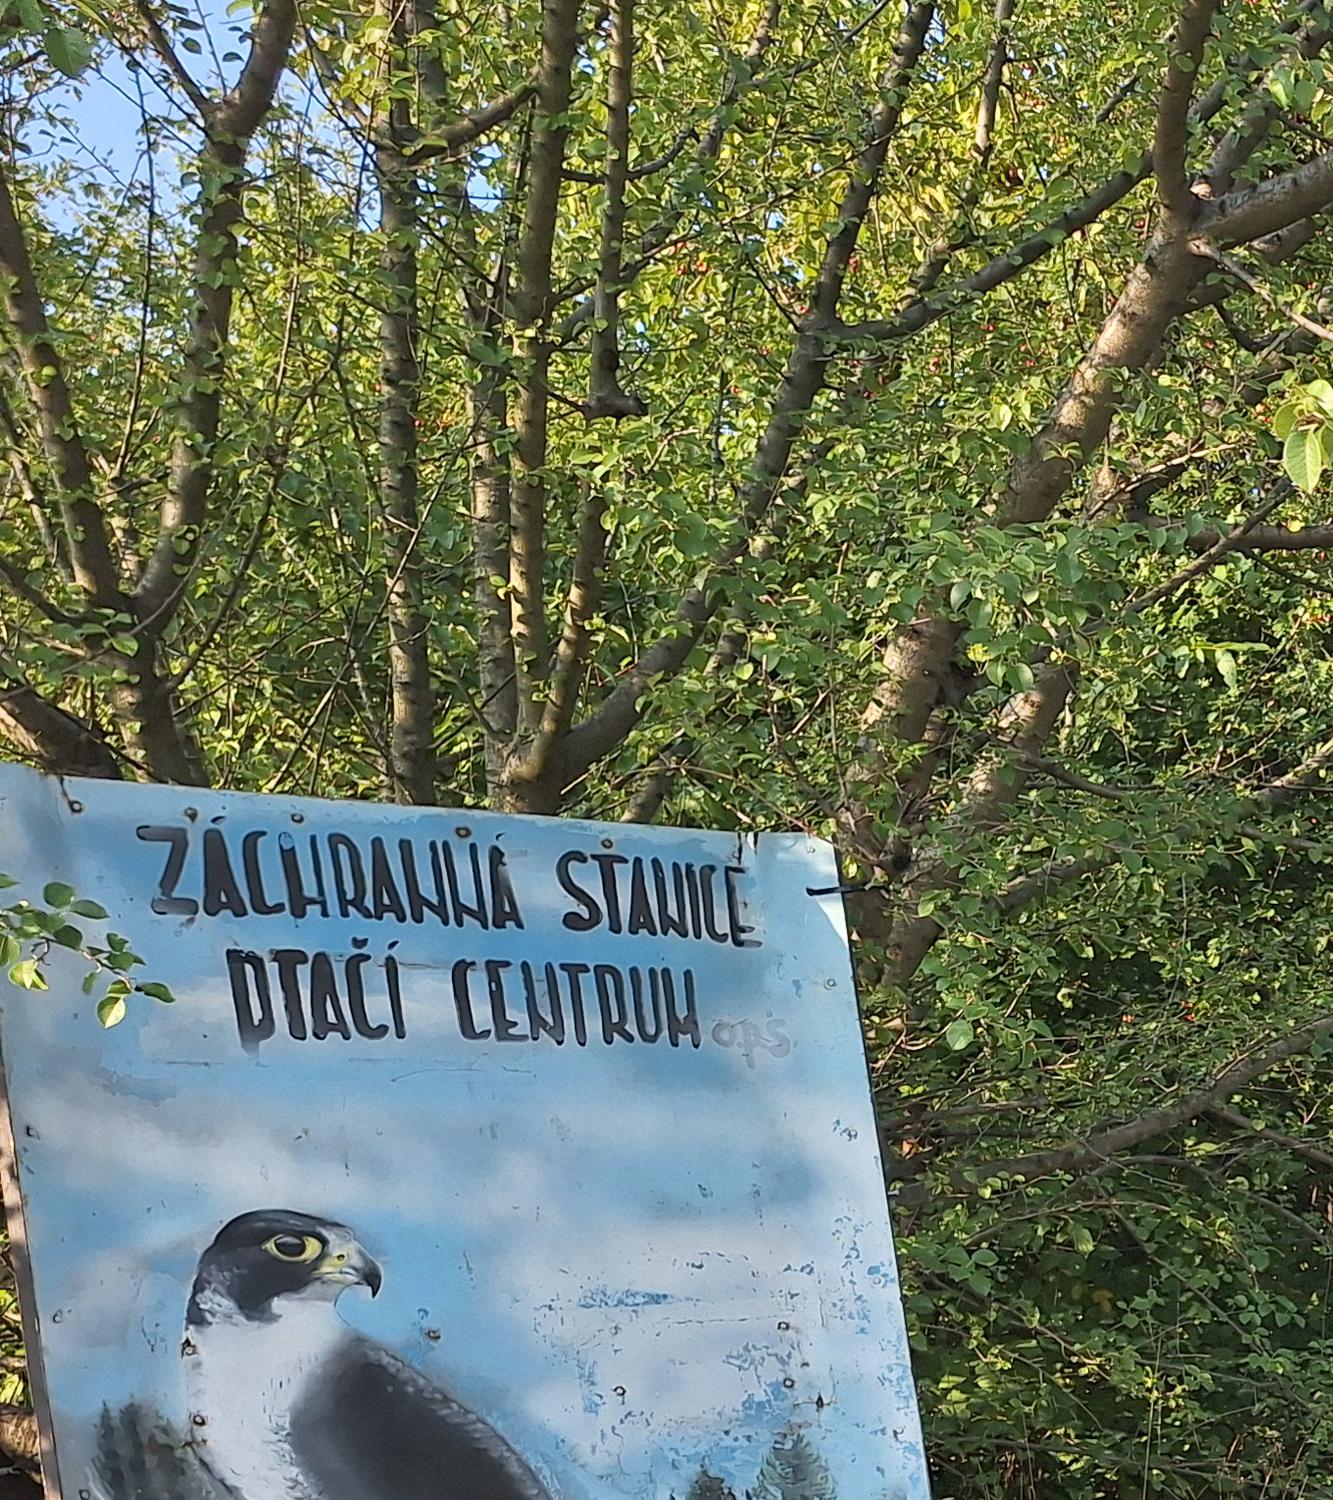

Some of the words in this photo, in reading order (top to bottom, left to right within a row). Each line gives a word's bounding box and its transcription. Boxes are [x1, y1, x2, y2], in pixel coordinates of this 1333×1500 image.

[136, 815, 526, 931] ZÁCHRANNÁ
[557, 848, 763, 949] STANICE
[226, 938, 407, 1052] PTAČÍ
[452, 959, 702, 1049] CENTRUM
